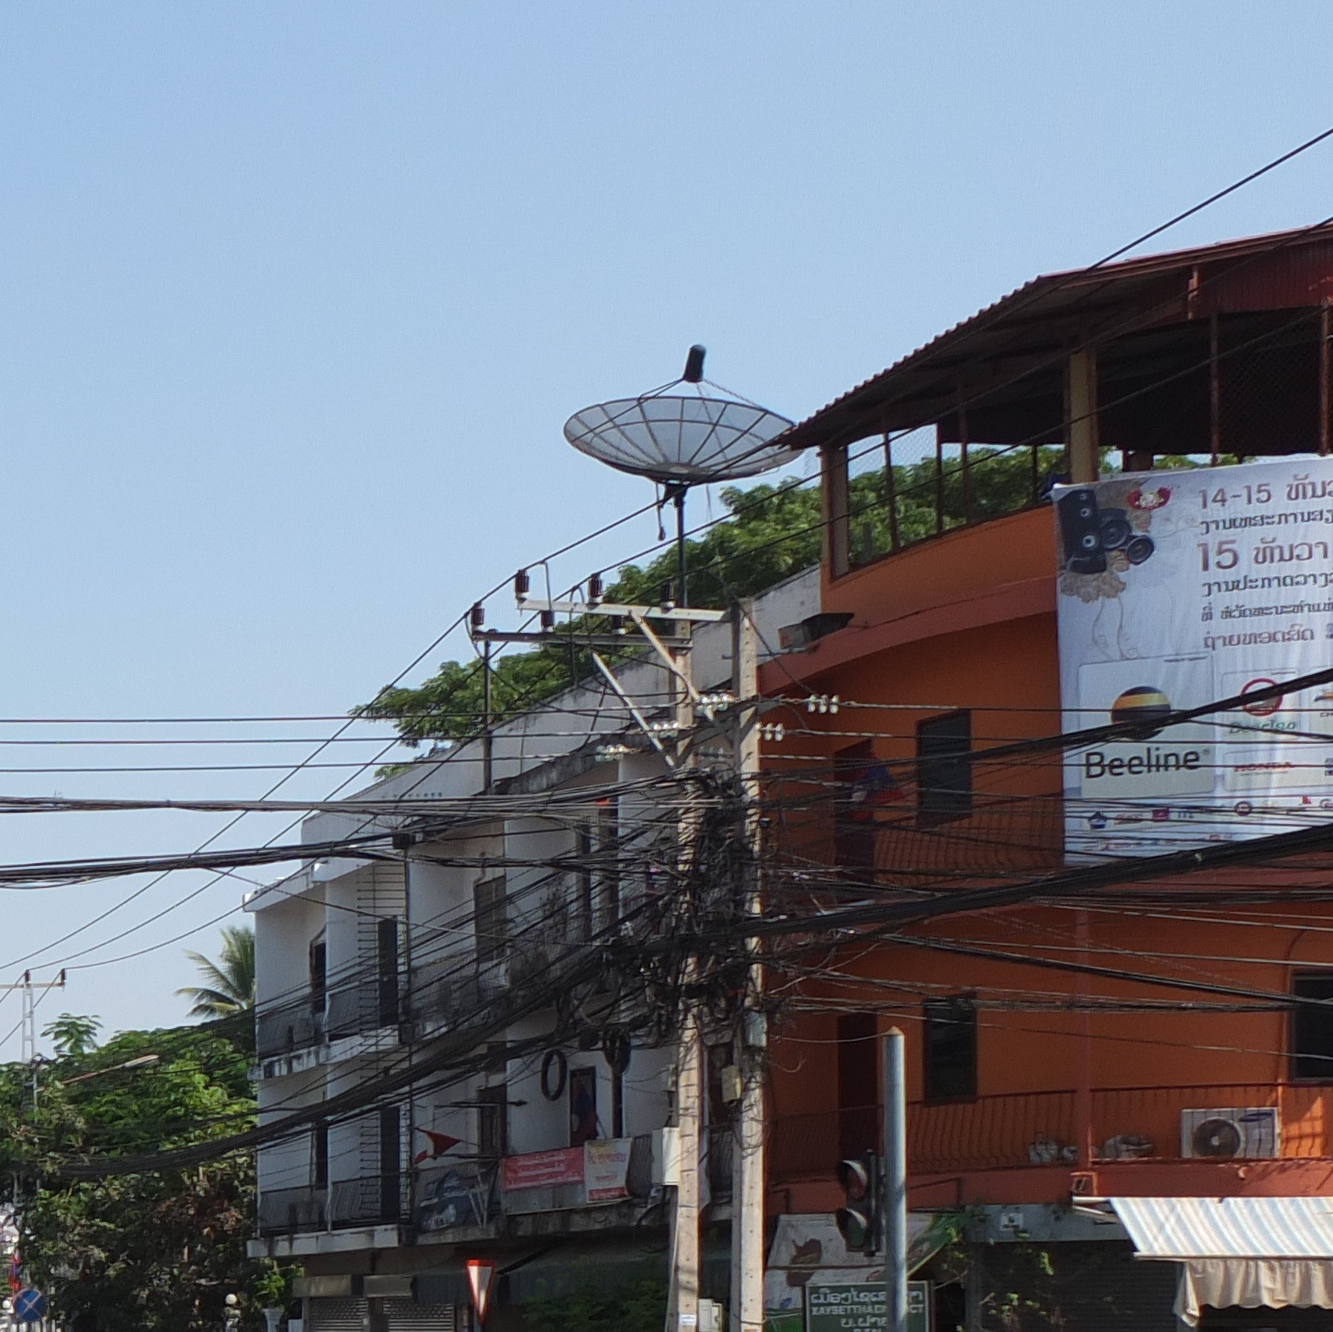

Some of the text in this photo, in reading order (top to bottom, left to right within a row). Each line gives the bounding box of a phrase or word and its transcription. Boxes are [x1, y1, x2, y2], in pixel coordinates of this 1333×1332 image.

[1198, 483, 1272, 509] 14-15
[1197, 537, 1329, 572] 15 ທັນວາ
[1085, 746, 1201, 779] Beeline
